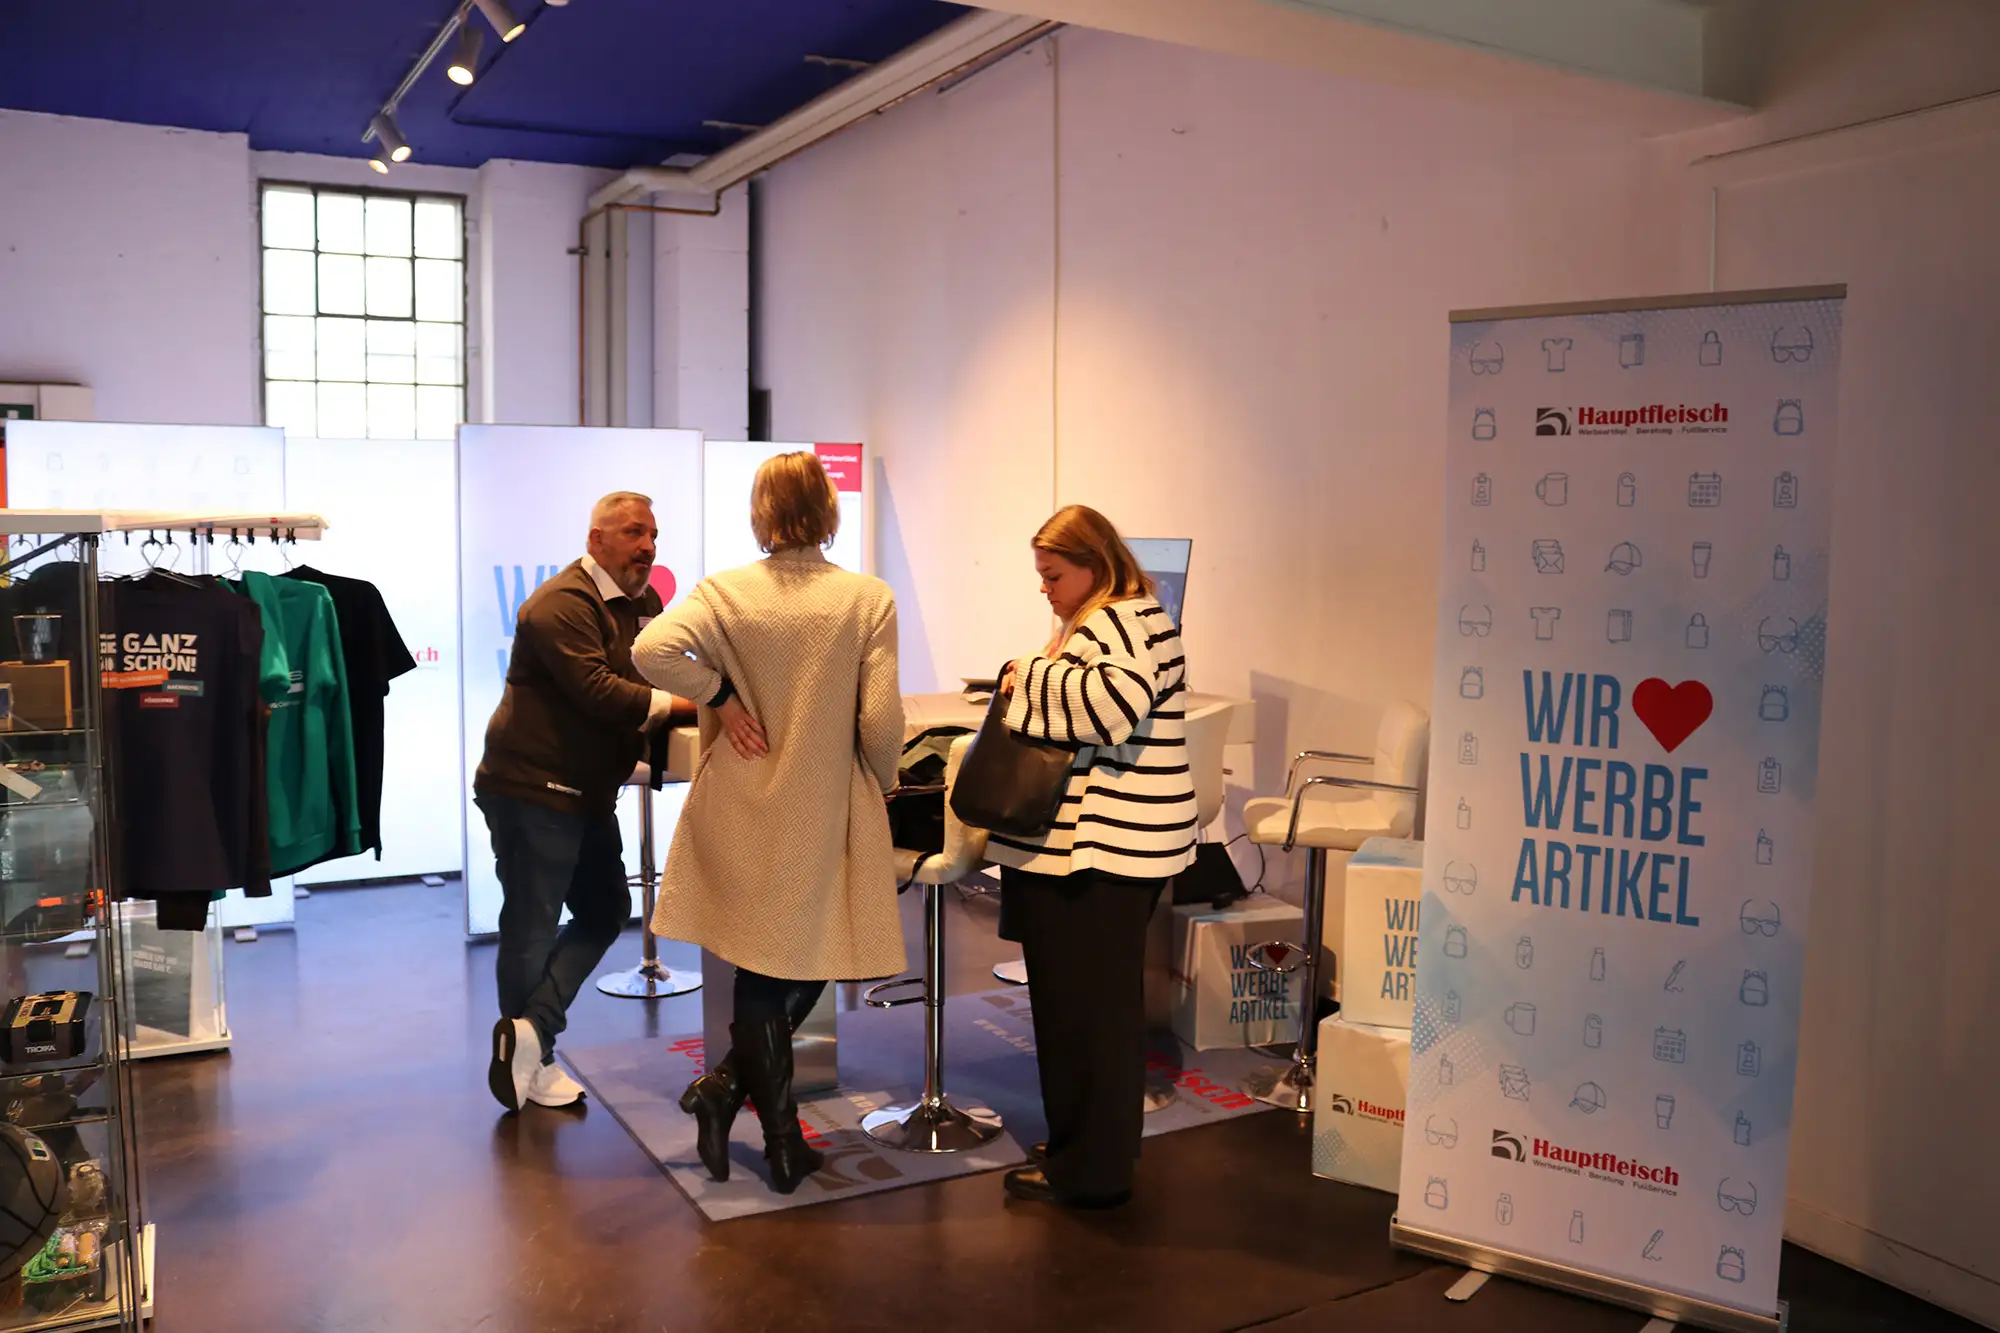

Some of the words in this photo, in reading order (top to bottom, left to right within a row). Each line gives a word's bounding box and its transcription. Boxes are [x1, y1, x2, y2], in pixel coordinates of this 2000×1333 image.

[1578, 403, 1729, 427] Hauptfleisch
[122, 632, 198, 655] GANZ
[123, 653, 197, 672] SCHÖN!
[1522, 669, 1622, 749] WIR
[1519, 752, 1709, 847] WERBE
[1510, 838, 1700, 927] ARTIKEL
[1231, 970, 1289, 998] WERBE
[1230, 997, 1289, 1024] ARTIKEL
[1532, 1137, 1680, 1187] Hauptfleisch
